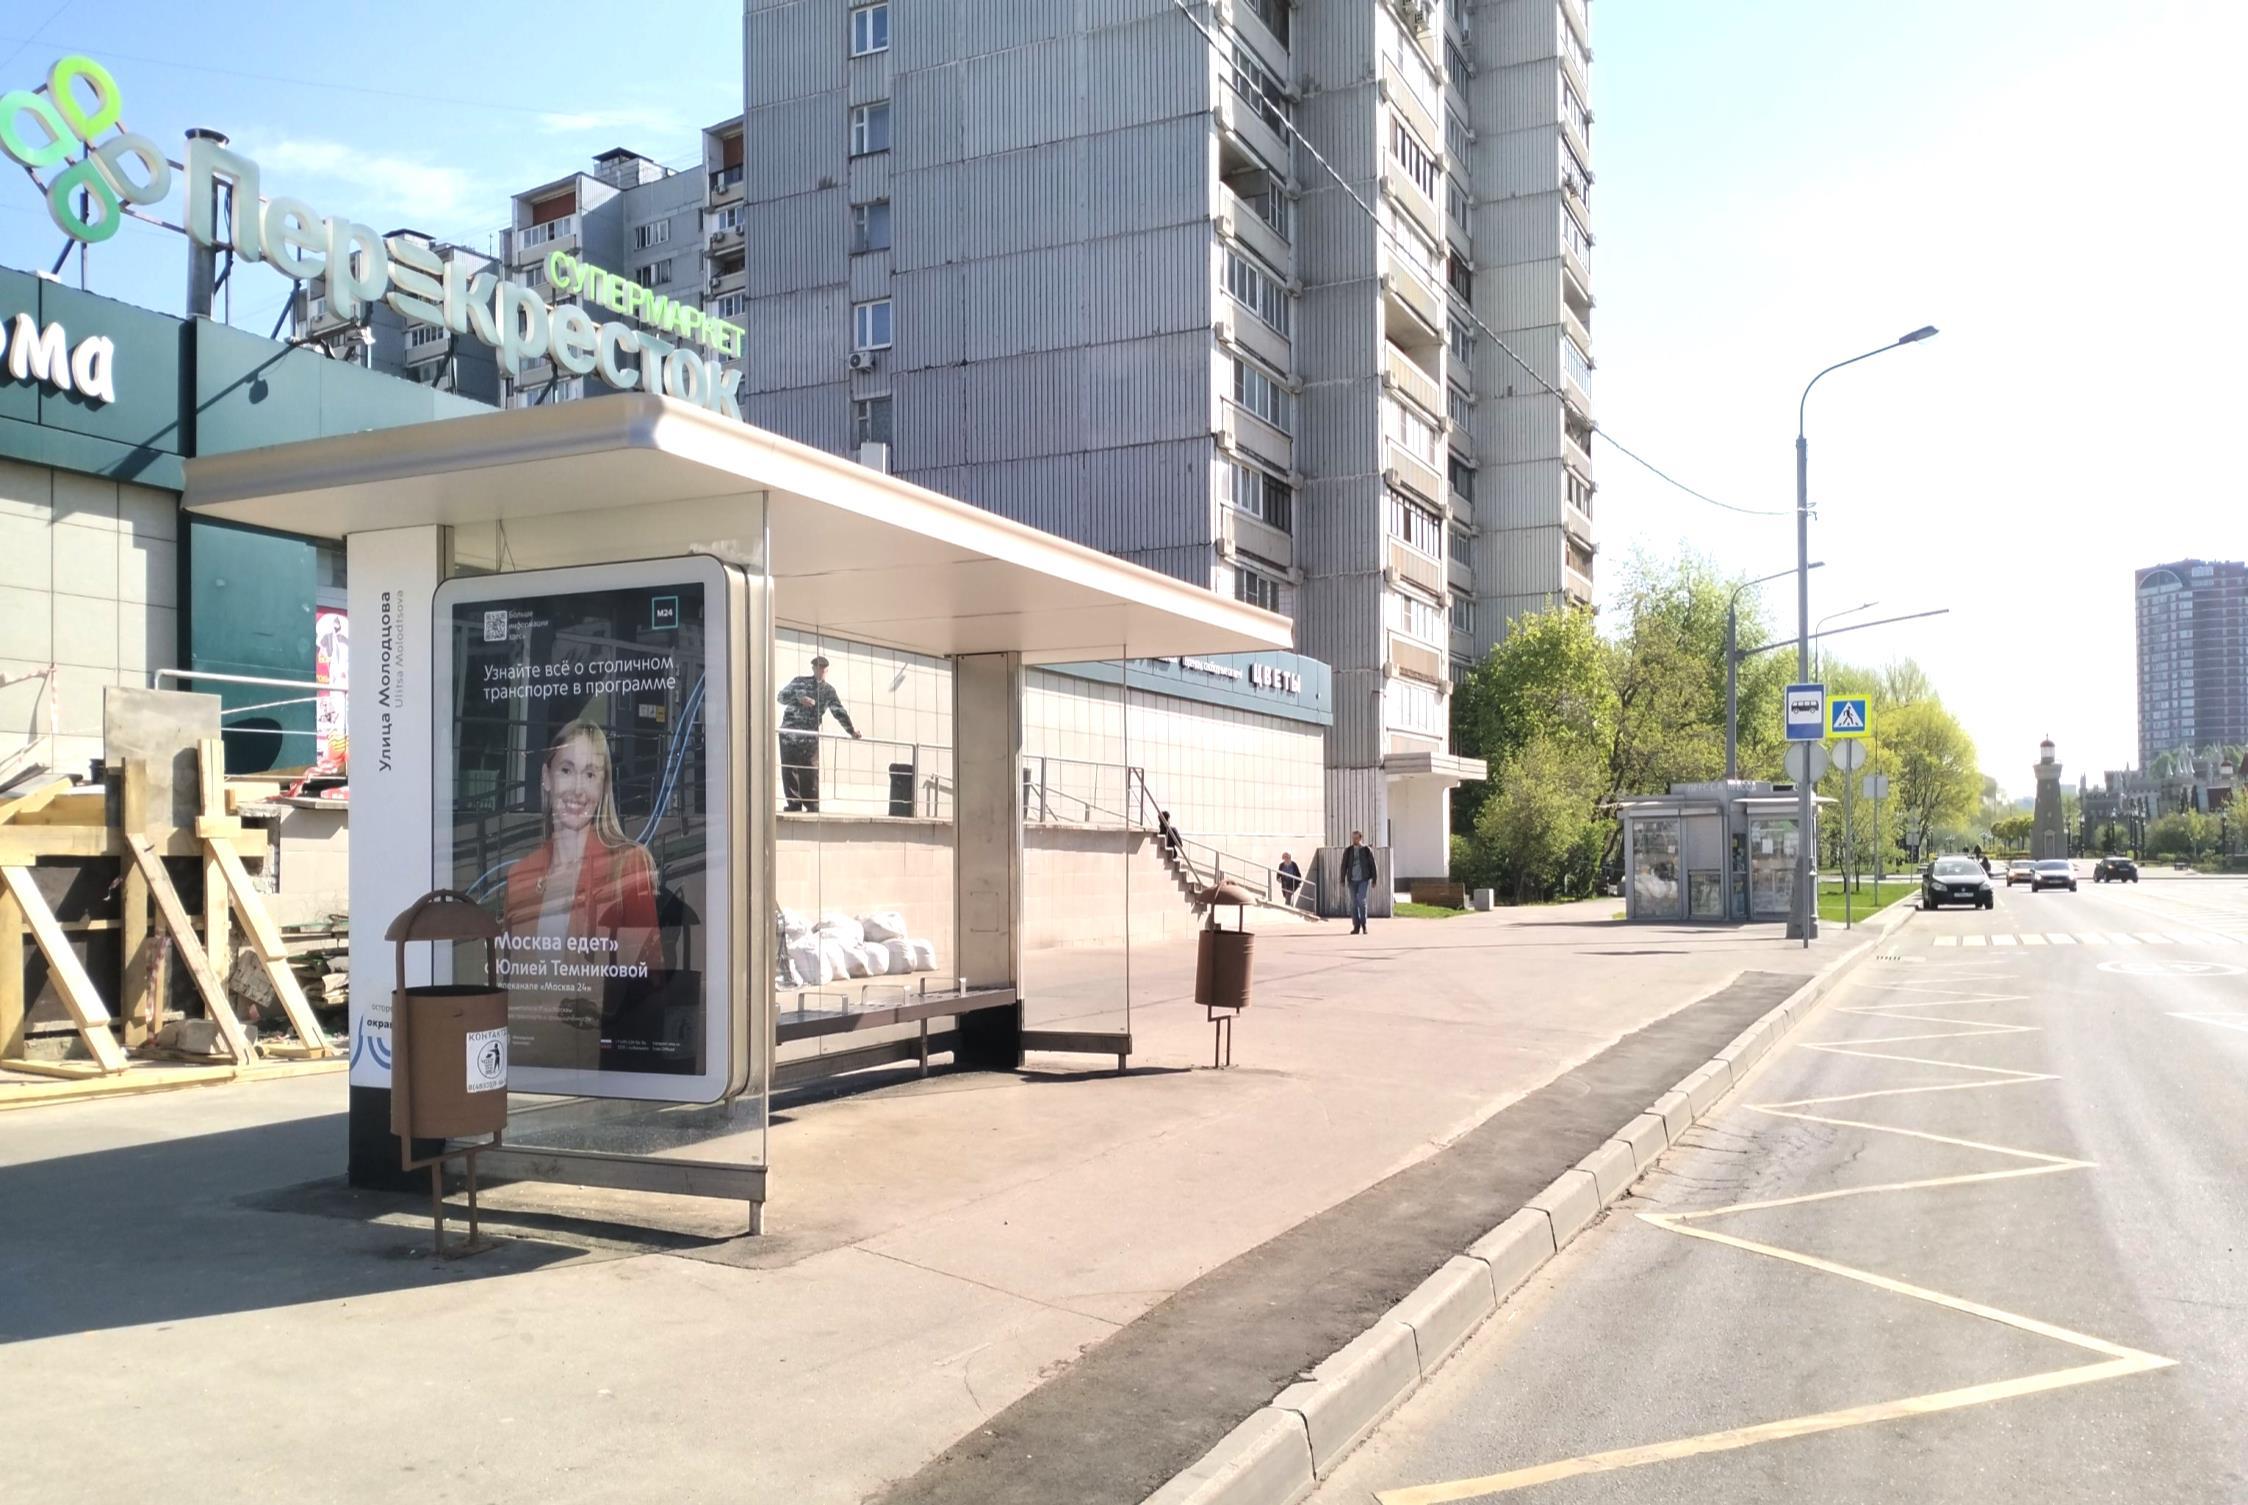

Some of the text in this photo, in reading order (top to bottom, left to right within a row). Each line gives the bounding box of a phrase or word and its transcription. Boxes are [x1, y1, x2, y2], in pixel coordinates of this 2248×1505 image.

[544, 250, 746, 359] СУПЕРМАРКЕТ
[394, 590, 404, 708] Ulitsa Molodtsova
[378, 591, 392, 772] Улица Молодцова
[484, 656, 674, 682] Узнайте всё о столичном
[1252, 662, 1301, 694] ЦВЕТЫ
[483, 676, 676, 703] транспорте в программе
[566, 936, 619, 954] едет»
[495, 959, 547, 977] Юлией
[551, 960, 649, 979] Темниковой
